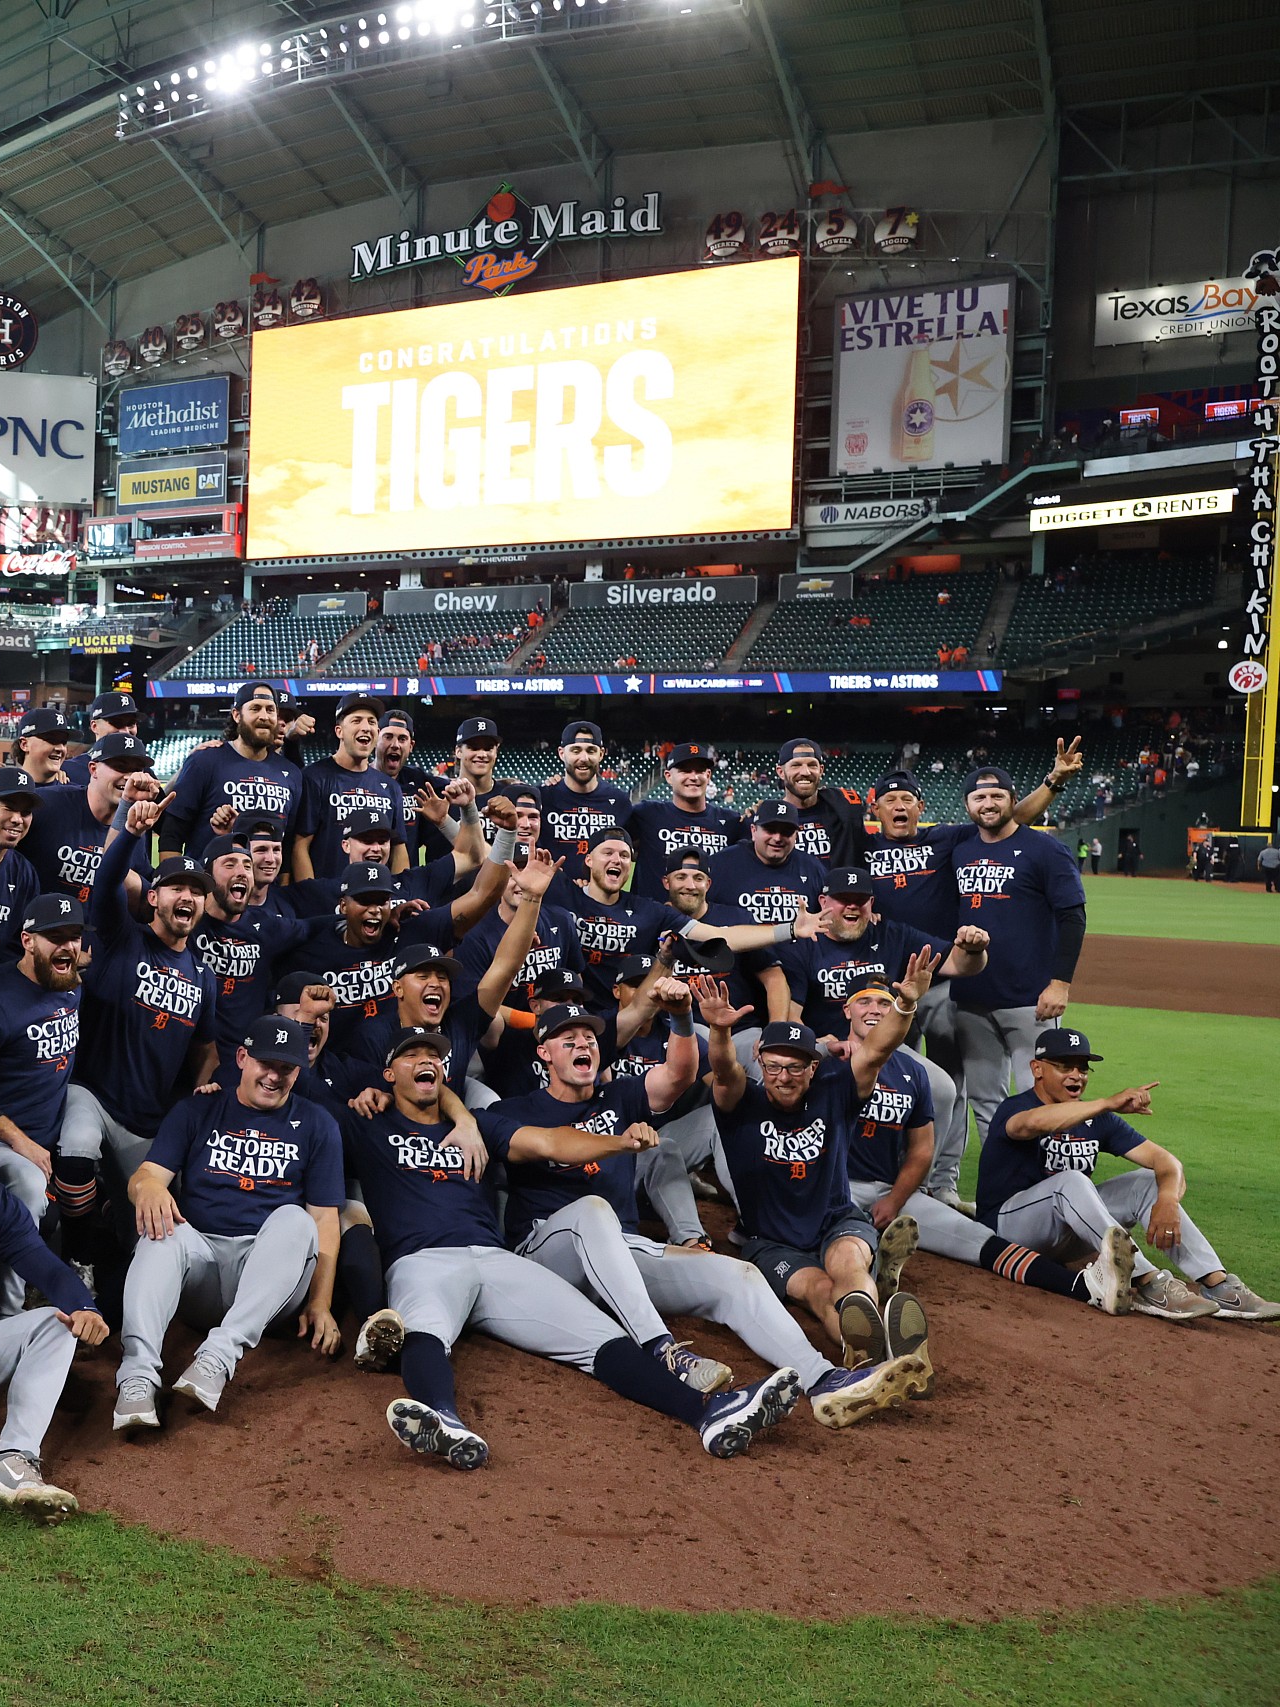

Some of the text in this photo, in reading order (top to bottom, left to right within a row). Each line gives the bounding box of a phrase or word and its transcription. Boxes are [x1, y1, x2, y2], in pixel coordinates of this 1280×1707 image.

[707, 211, 743, 239] 49
[760, 209, 797, 237] 24
[826, 209, 844, 236] 5
[886, 207, 906, 234] 7
[351, 192, 662, 280] Minute Maid
[710, 241, 740, 250] DIERKER
[768, 239, 790, 247] WYNN
[819, 238, 853, 248] BAGWELL
[881, 238, 909, 246] BIGGIO
[463, 250, 538, 291] Park
[291, 278, 318, 302] 42
[933, 287, 980, 314] TU
[1108, 284, 1259, 321] Texas Bay
[1160, 315, 1258, 336] CREDIT UNION
[358, 316, 658, 374] CONGRATULATIONS
[126, 400, 164, 412] HOUSTON
[126, 399, 220, 429] Methodist
[150, 422, 220, 436] LEADING MEDICINE
[341, 348, 674, 515] TIGERS
[131, 472, 221, 496] MUSTANG CAT
[1249, 441, 1275, 511] THA
[844, 503, 921, 521] NABORS
[1039, 496, 1218, 525] DOGGETT RENTS
[481, 555, 528, 564] CHEVROLET
[606, 582, 717, 605] Silverado
[1244, 520, 1271, 655] CHIKIN
[434, 591, 498, 613] Chevy
[69, 635, 133, 647] PLUCKERS
[84, 646, 117, 655] WING BAR
[187, 683, 216, 695] TIGERS
[475, 679, 564, 692] TIGERS vs ASTROS
[829, 675, 939, 689] TIGERS vs ASTROS
[224, 781, 291, 801] OCTOBER
[232, 795, 287, 814] READY
[329, 793, 393, 811] OCTOBER
[546, 811, 616, 828] OCTOBER
[658, 828, 728, 847] OCTOBER
[863, 845, 935, 865] OCTOBER
[870, 856, 929, 877] READY
[956, 865, 1015, 880] OCTOBER
[958, 877, 1007, 895] READY
[738, 893, 809, 909] OCTOBER
[196, 934, 260, 960] OCTOBER
[201, 951, 257, 977] READY
[135, 961, 202, 1004] OCTOBER
[135, 980, 198, 1019] READY
[207, 1129, 300, 1162] OCTOBER
[208, 1149, 291, 1180] READY
